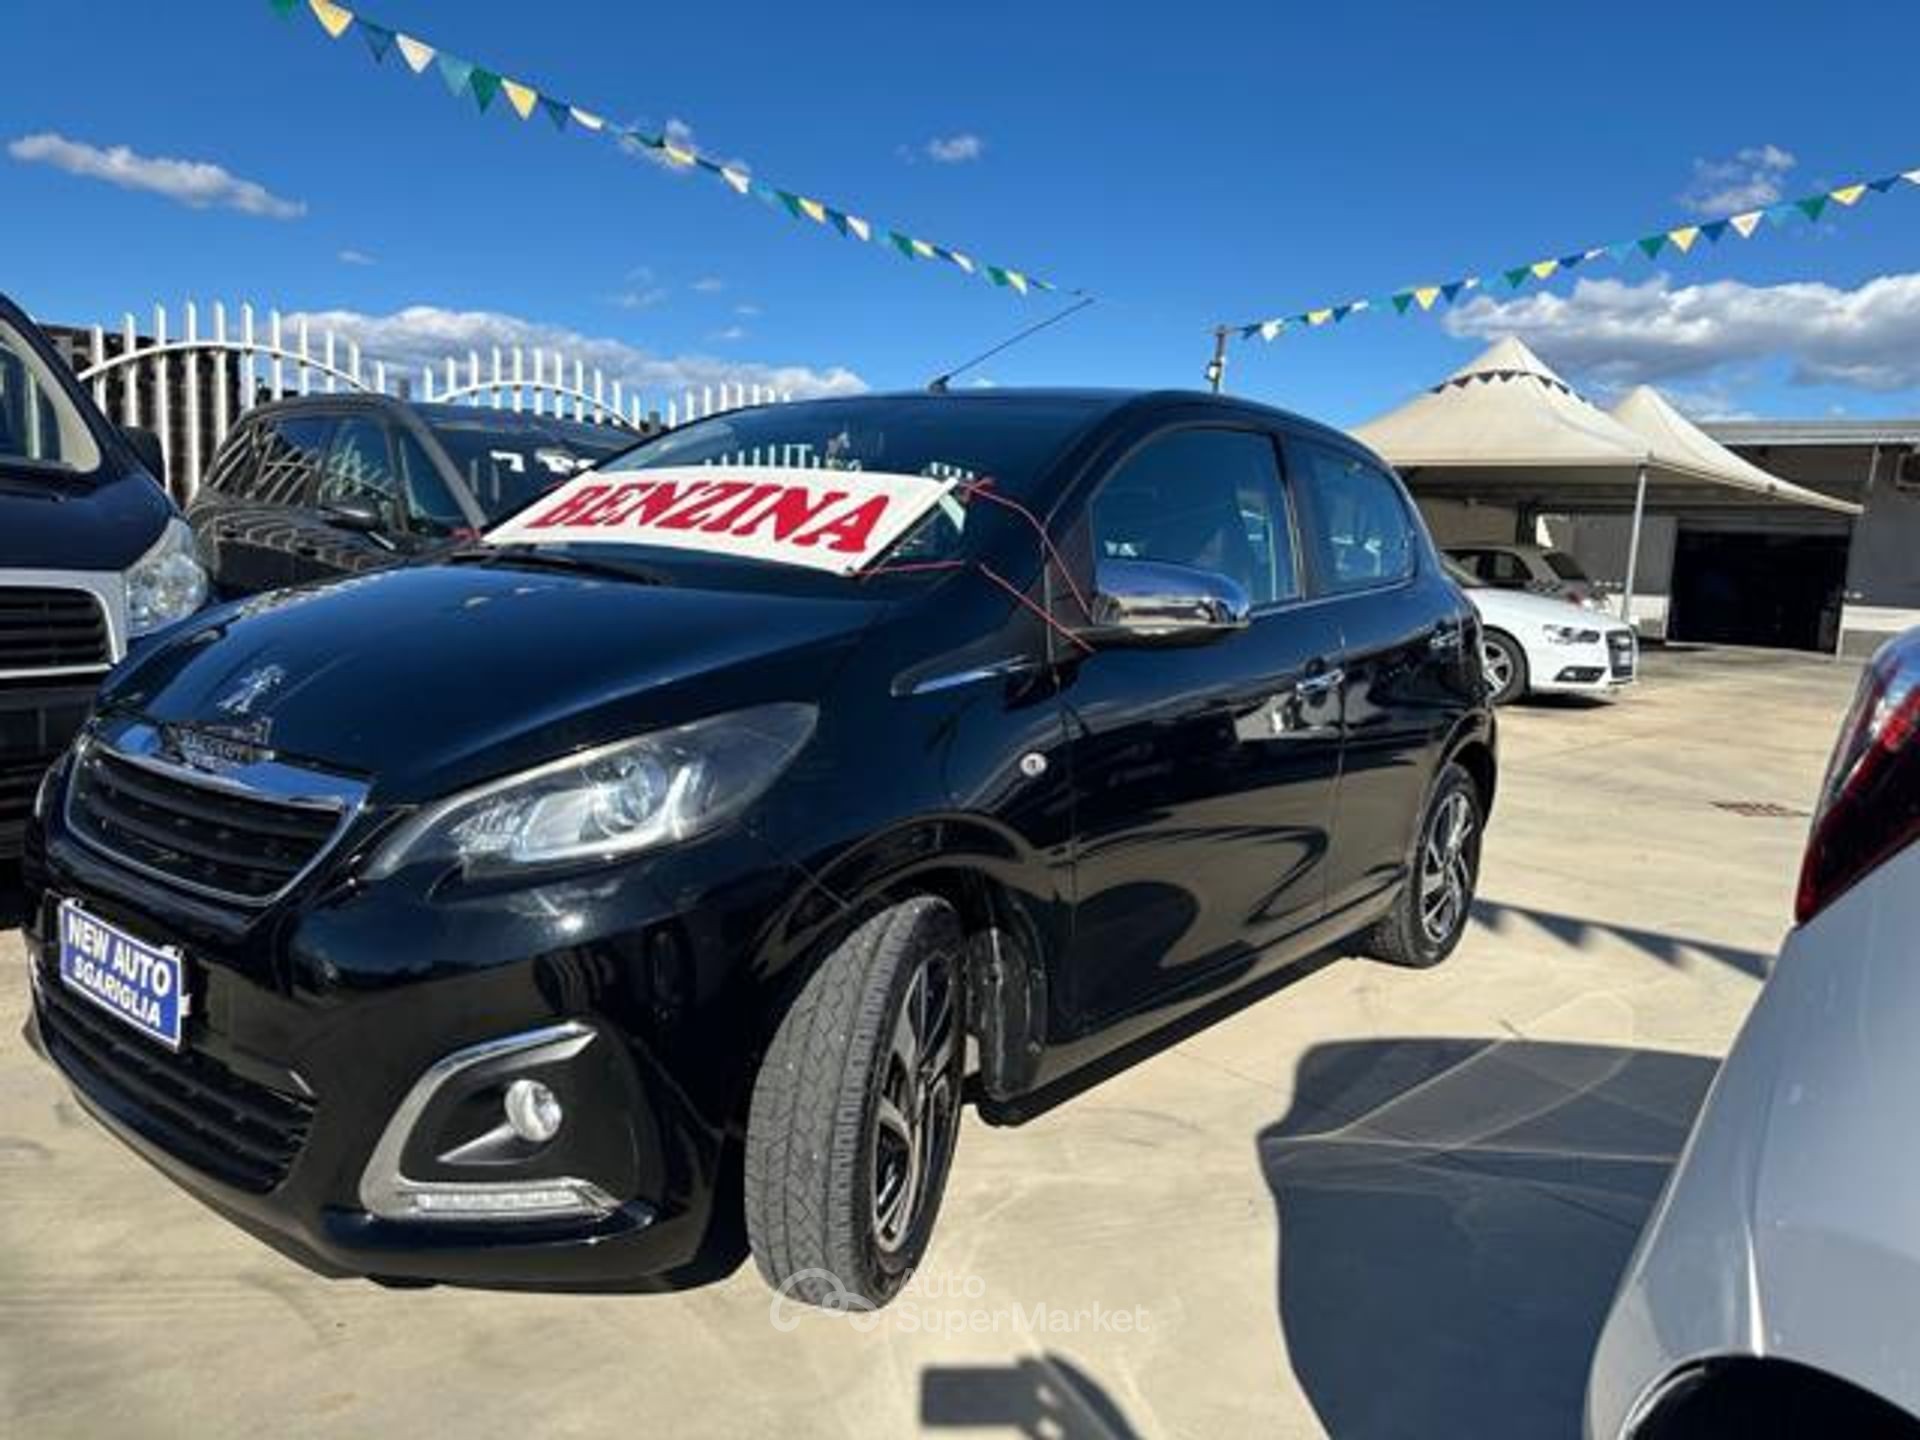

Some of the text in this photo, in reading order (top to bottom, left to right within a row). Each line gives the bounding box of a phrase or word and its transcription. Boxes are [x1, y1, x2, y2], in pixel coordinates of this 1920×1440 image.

[525, 480, 890, 552] BENZINA
[68, 912, 172, 997] NEW AUTO
